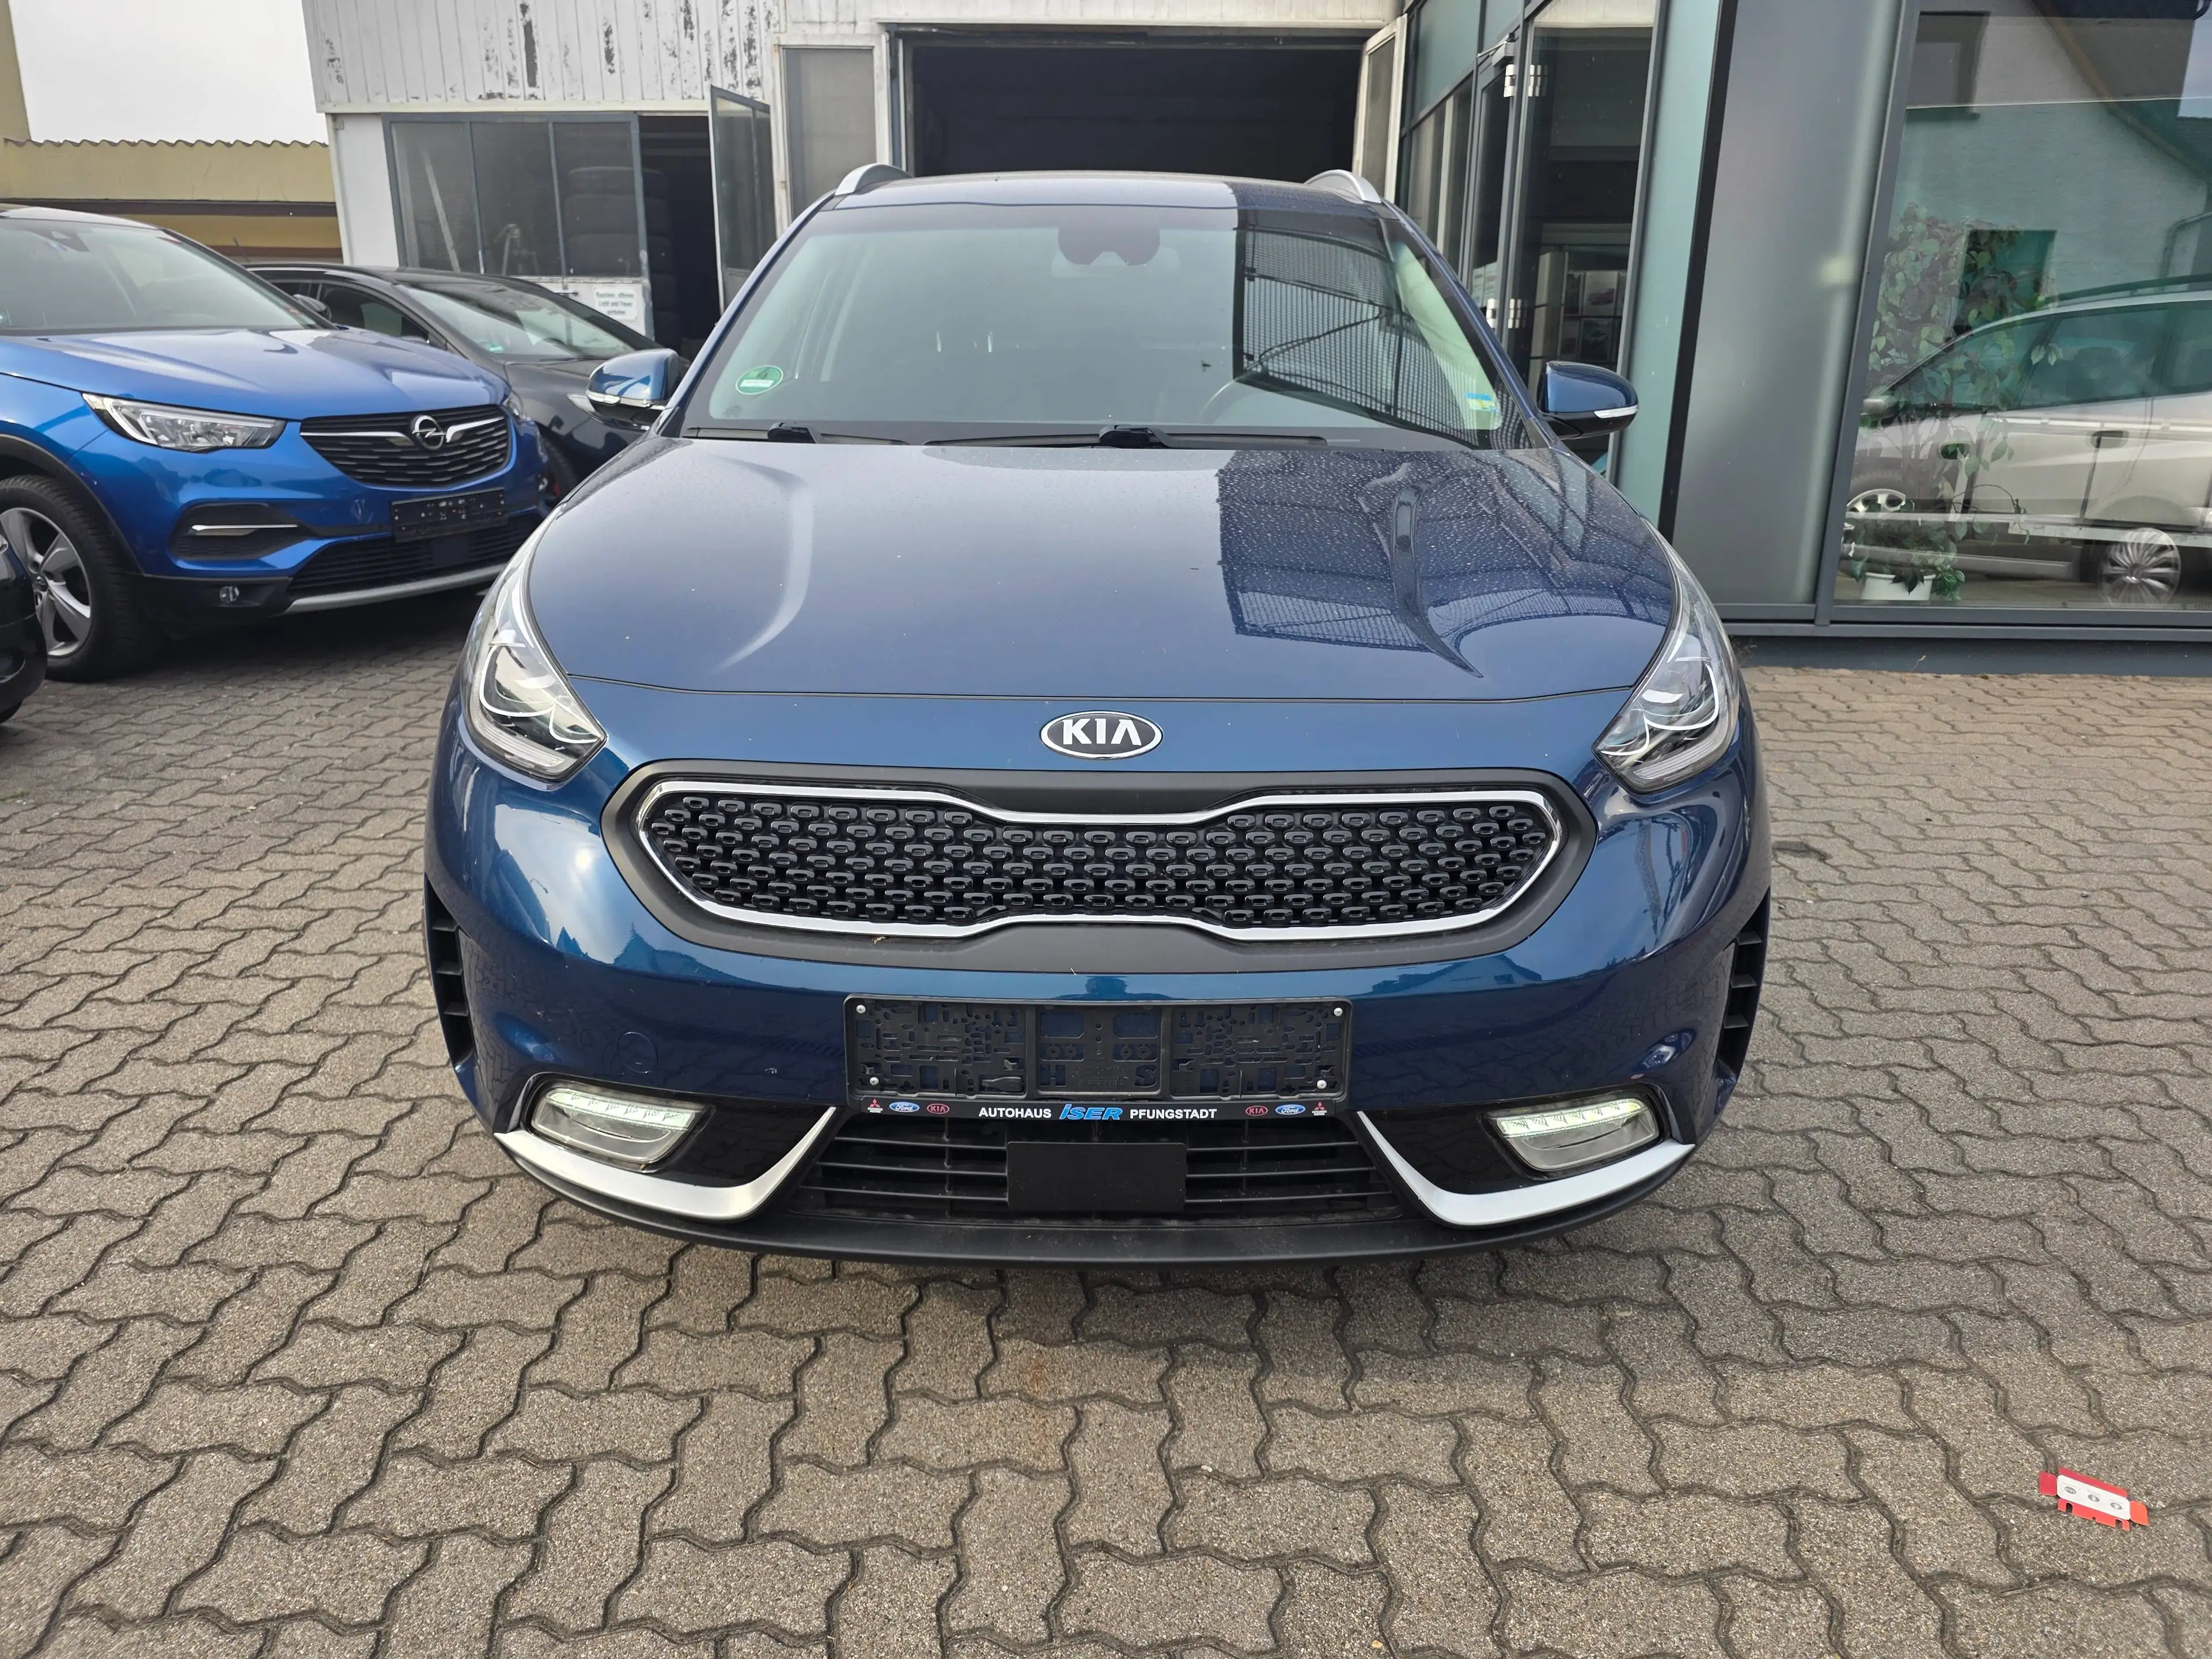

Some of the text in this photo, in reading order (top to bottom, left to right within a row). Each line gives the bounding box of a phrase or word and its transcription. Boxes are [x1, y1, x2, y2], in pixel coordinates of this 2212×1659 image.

[1062, 718, 1142, 746] KIA
[930, 1105, 946, 1113] KIA
[978, 1107, 1052, 1119] AUTOHAUS
[1130, 1108, 1218, 1120] PFUNGSTADT
